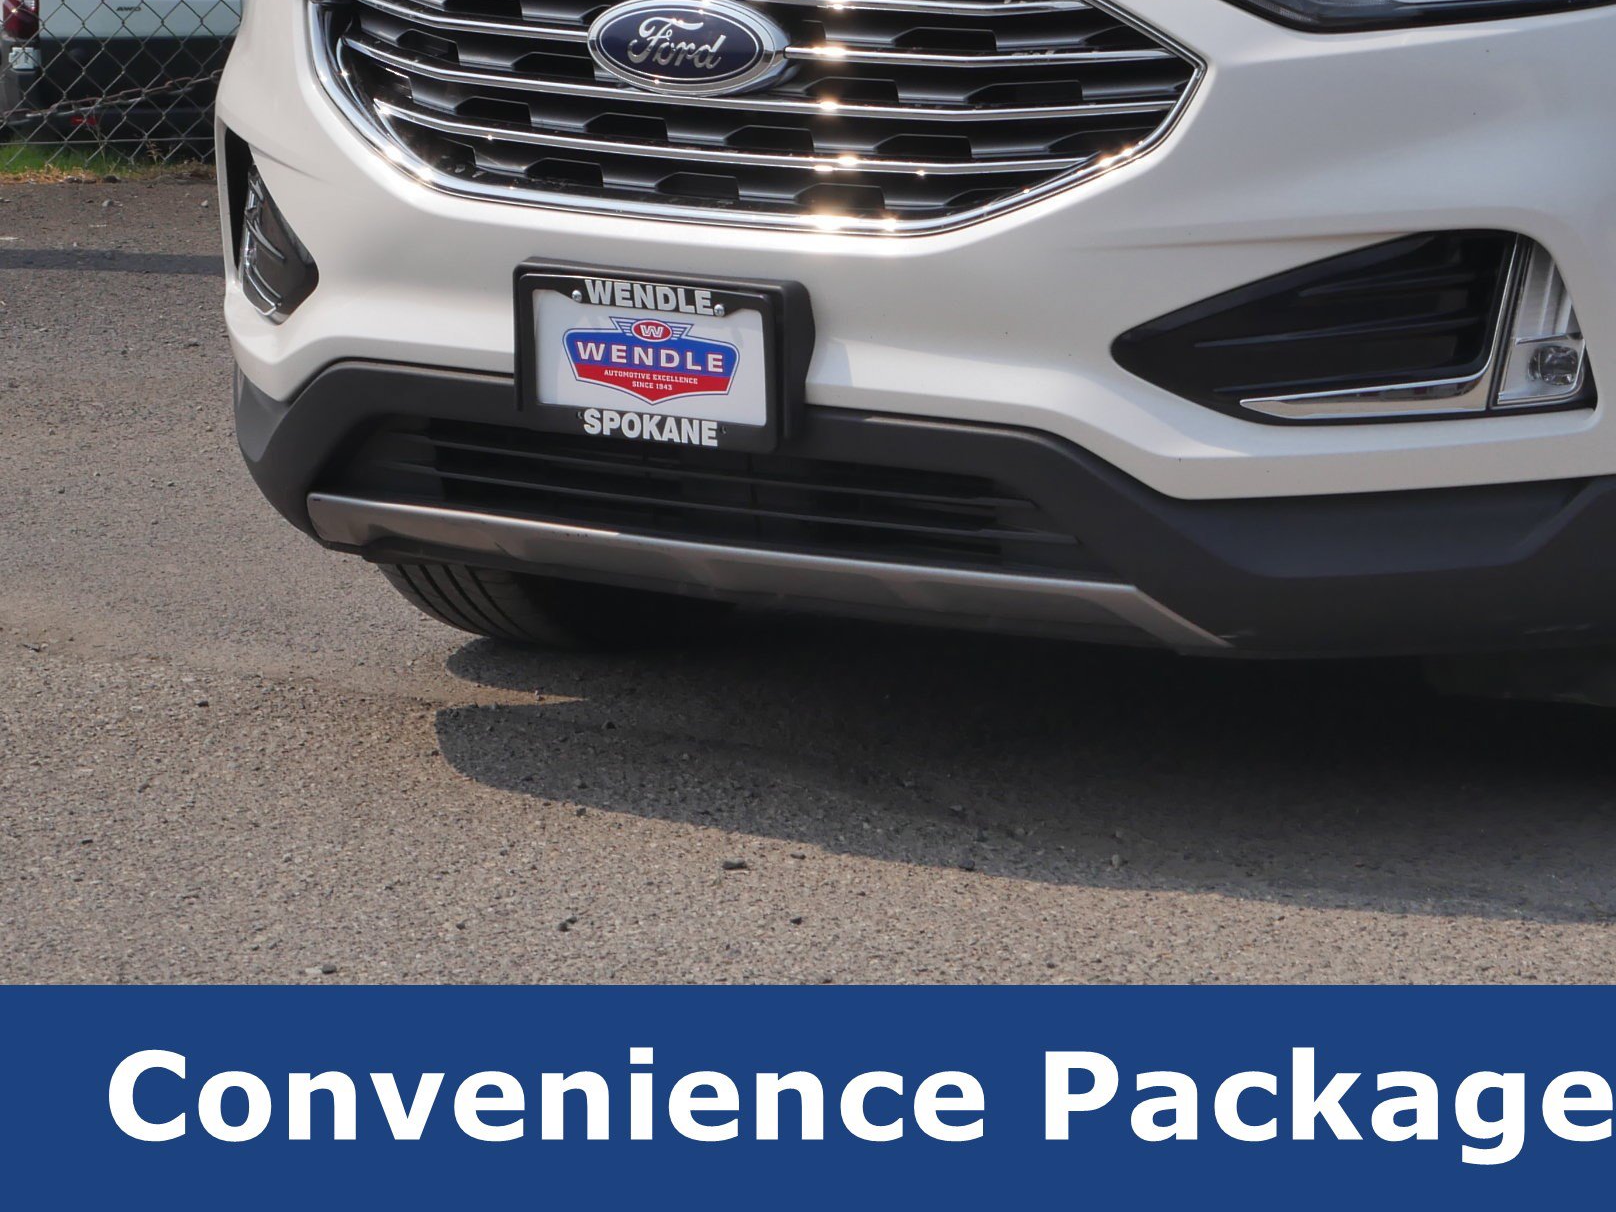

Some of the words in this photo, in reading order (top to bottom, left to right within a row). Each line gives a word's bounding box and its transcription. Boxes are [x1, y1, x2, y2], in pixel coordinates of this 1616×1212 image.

[627, 16, 726, 69] Ford
[584, 279, 714, 316] WENDLE
[576, 341, 723, 373] WENDLE
[604, 369, 651, 380] AUTOMOTIVE
[652, 374, 698, 385] EXCELLENCE
[632, 381, 653, 389] SINCE
[583, 408, 718, 447] SPOKANE
